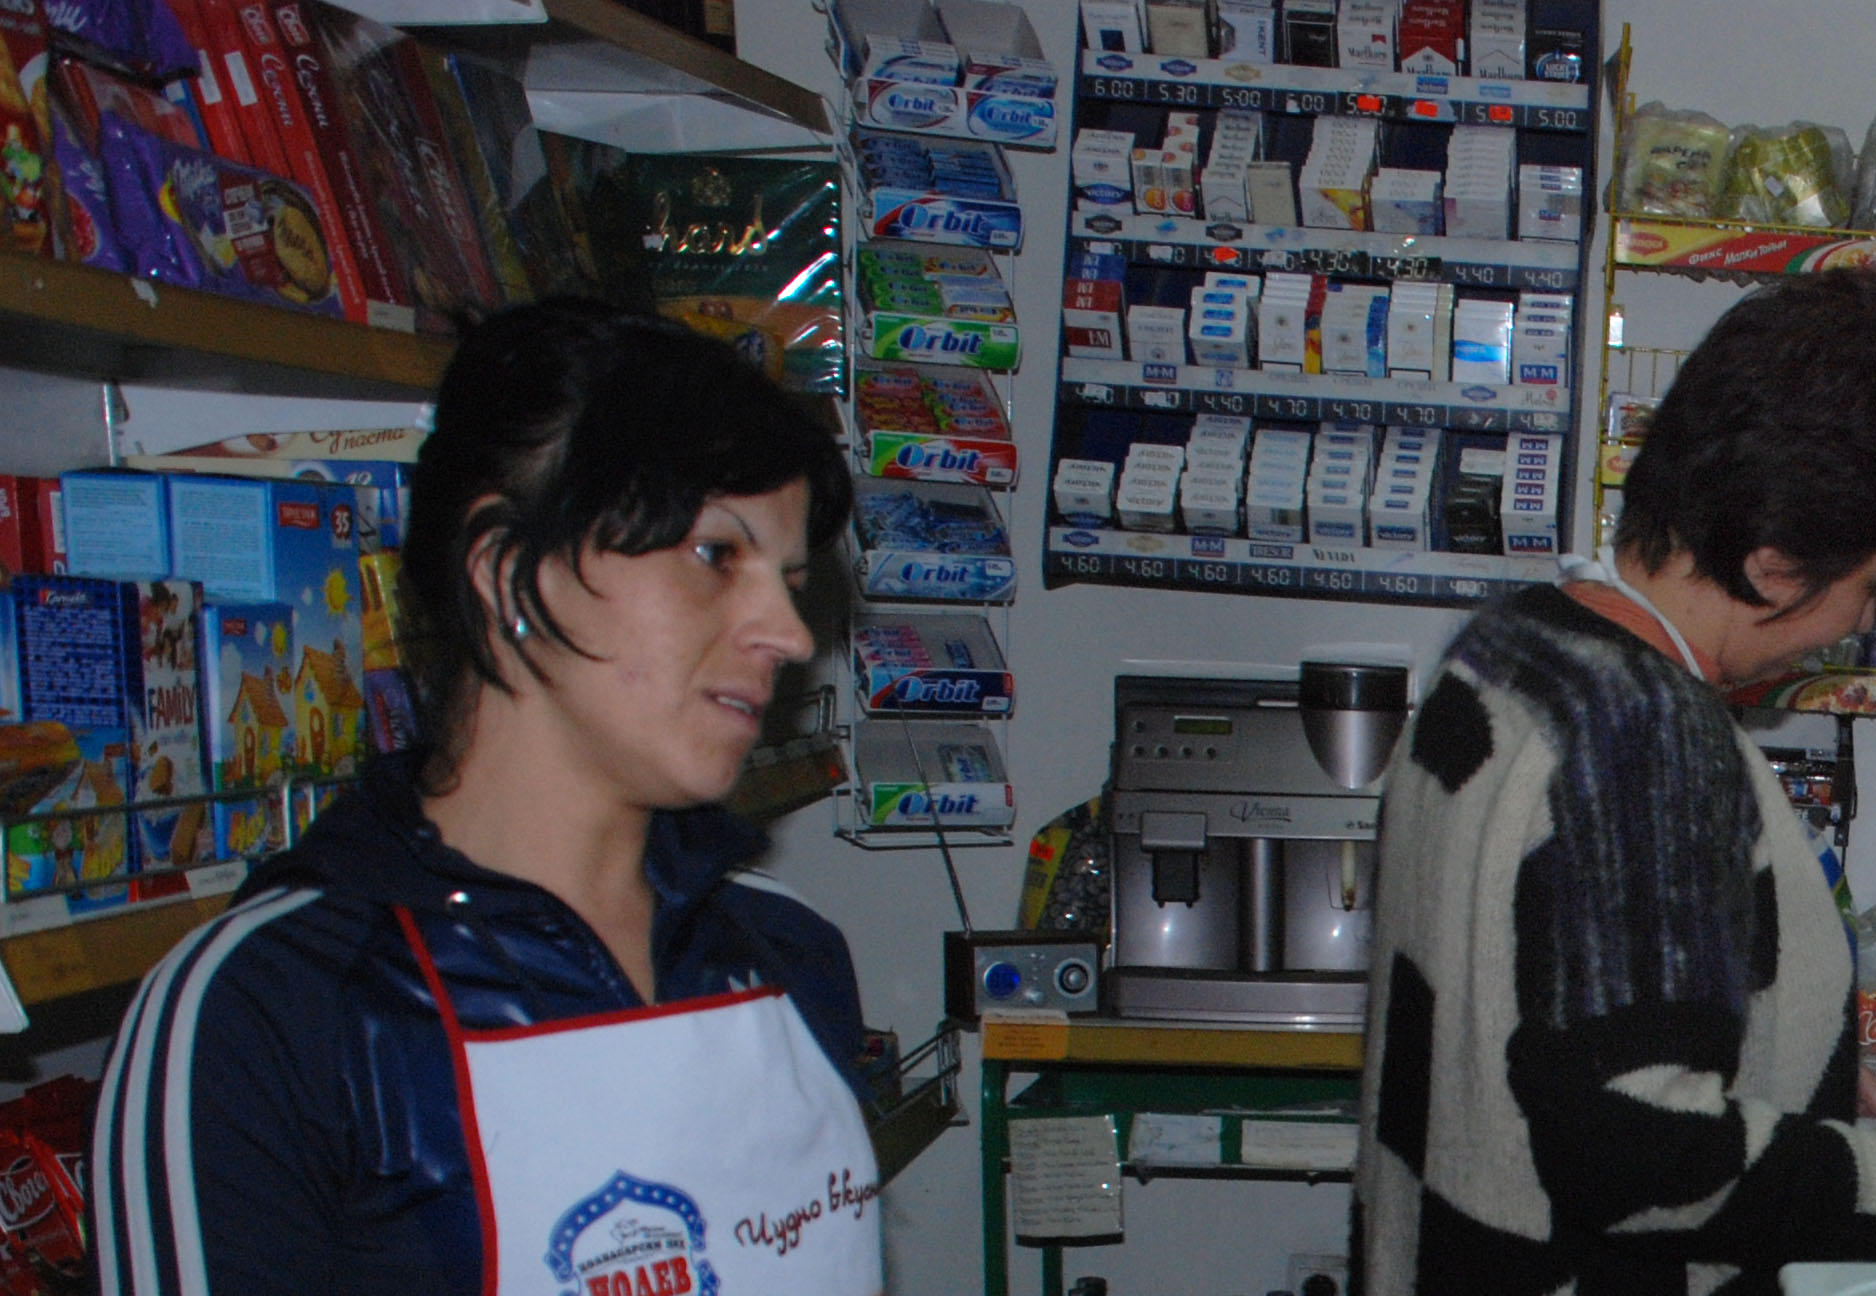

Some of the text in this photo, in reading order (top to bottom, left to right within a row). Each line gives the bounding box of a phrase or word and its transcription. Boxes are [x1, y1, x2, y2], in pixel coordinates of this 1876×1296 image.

[900, 204, 988, 235] Orbit
[899, 325, 983, 355] Orbit
[897, 443, 981, 473] Orbit
[902, 560, 970, 584] Orbit
[894, 676, 981, 704] Orbit
[897, 791, 979, 816] Orbit
